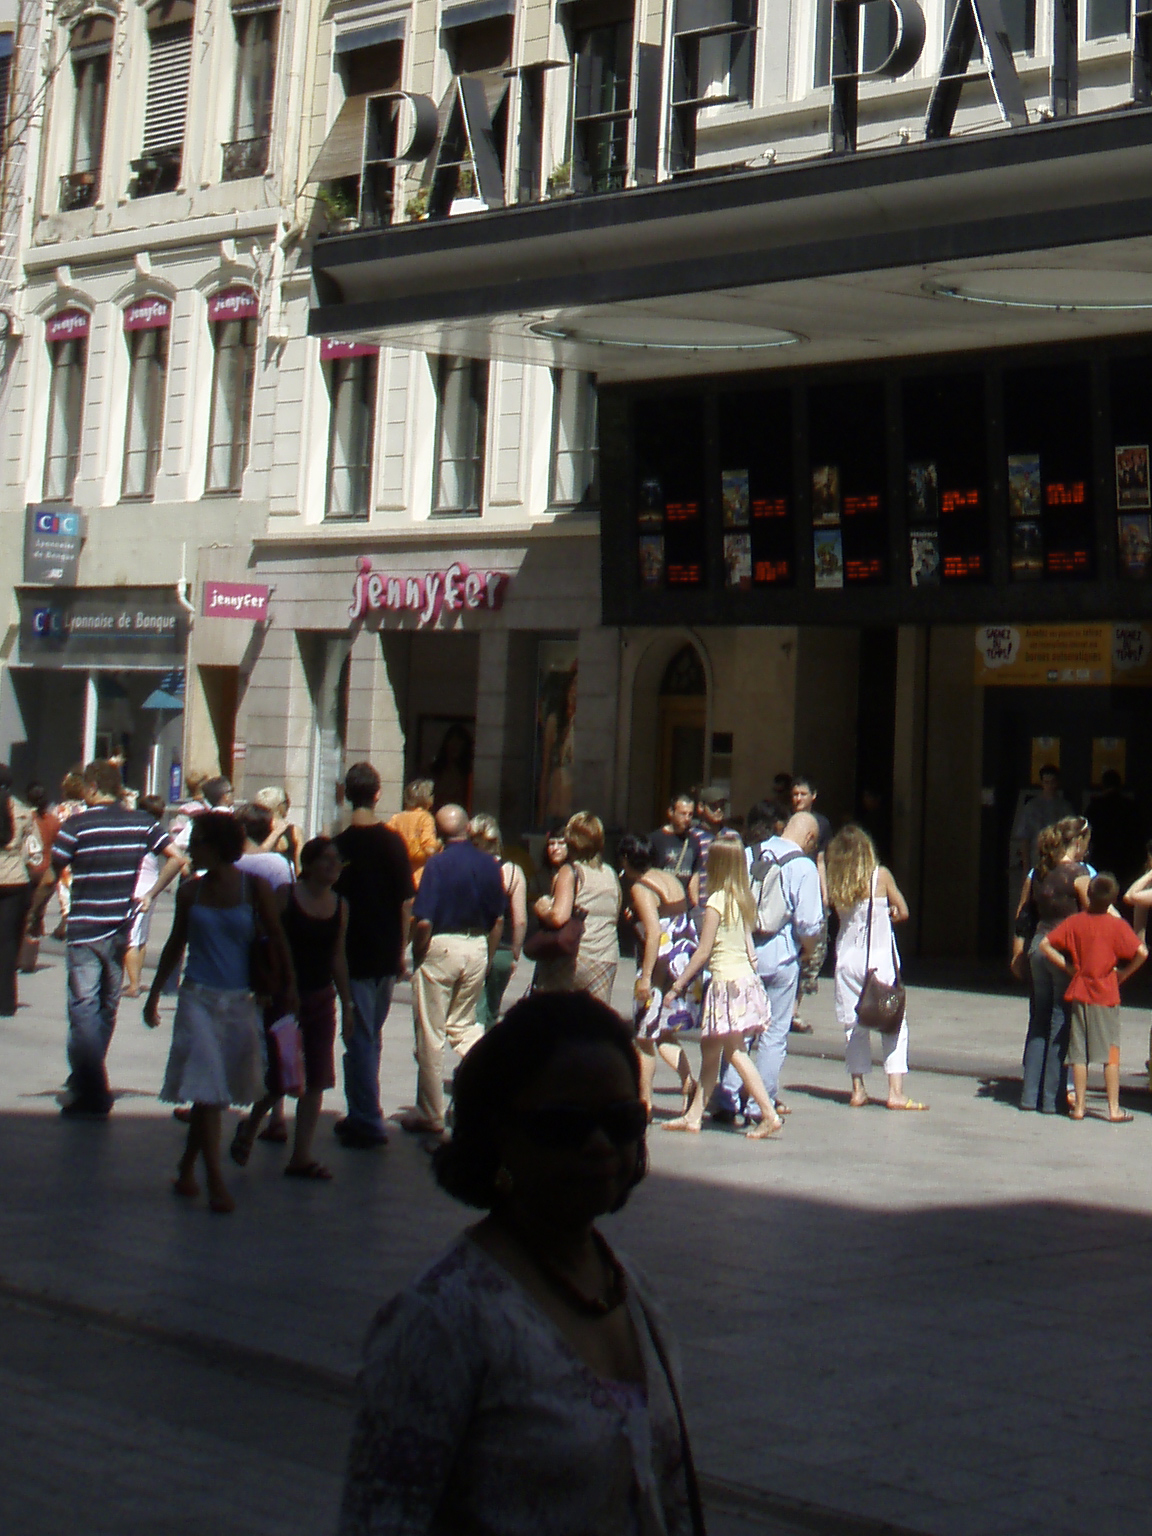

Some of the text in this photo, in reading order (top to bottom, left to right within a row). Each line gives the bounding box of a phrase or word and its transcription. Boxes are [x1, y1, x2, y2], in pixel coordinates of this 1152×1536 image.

[358, 20, 760, 227] PATHE
[209, 589, 265, 611] jennyfer
[347, 555, 510, 624] jennyfer
[65, 612, 114, 632] Lyonnaise
[118, 612, 131, 629] de
[134, 612, 176, 634] Banque
